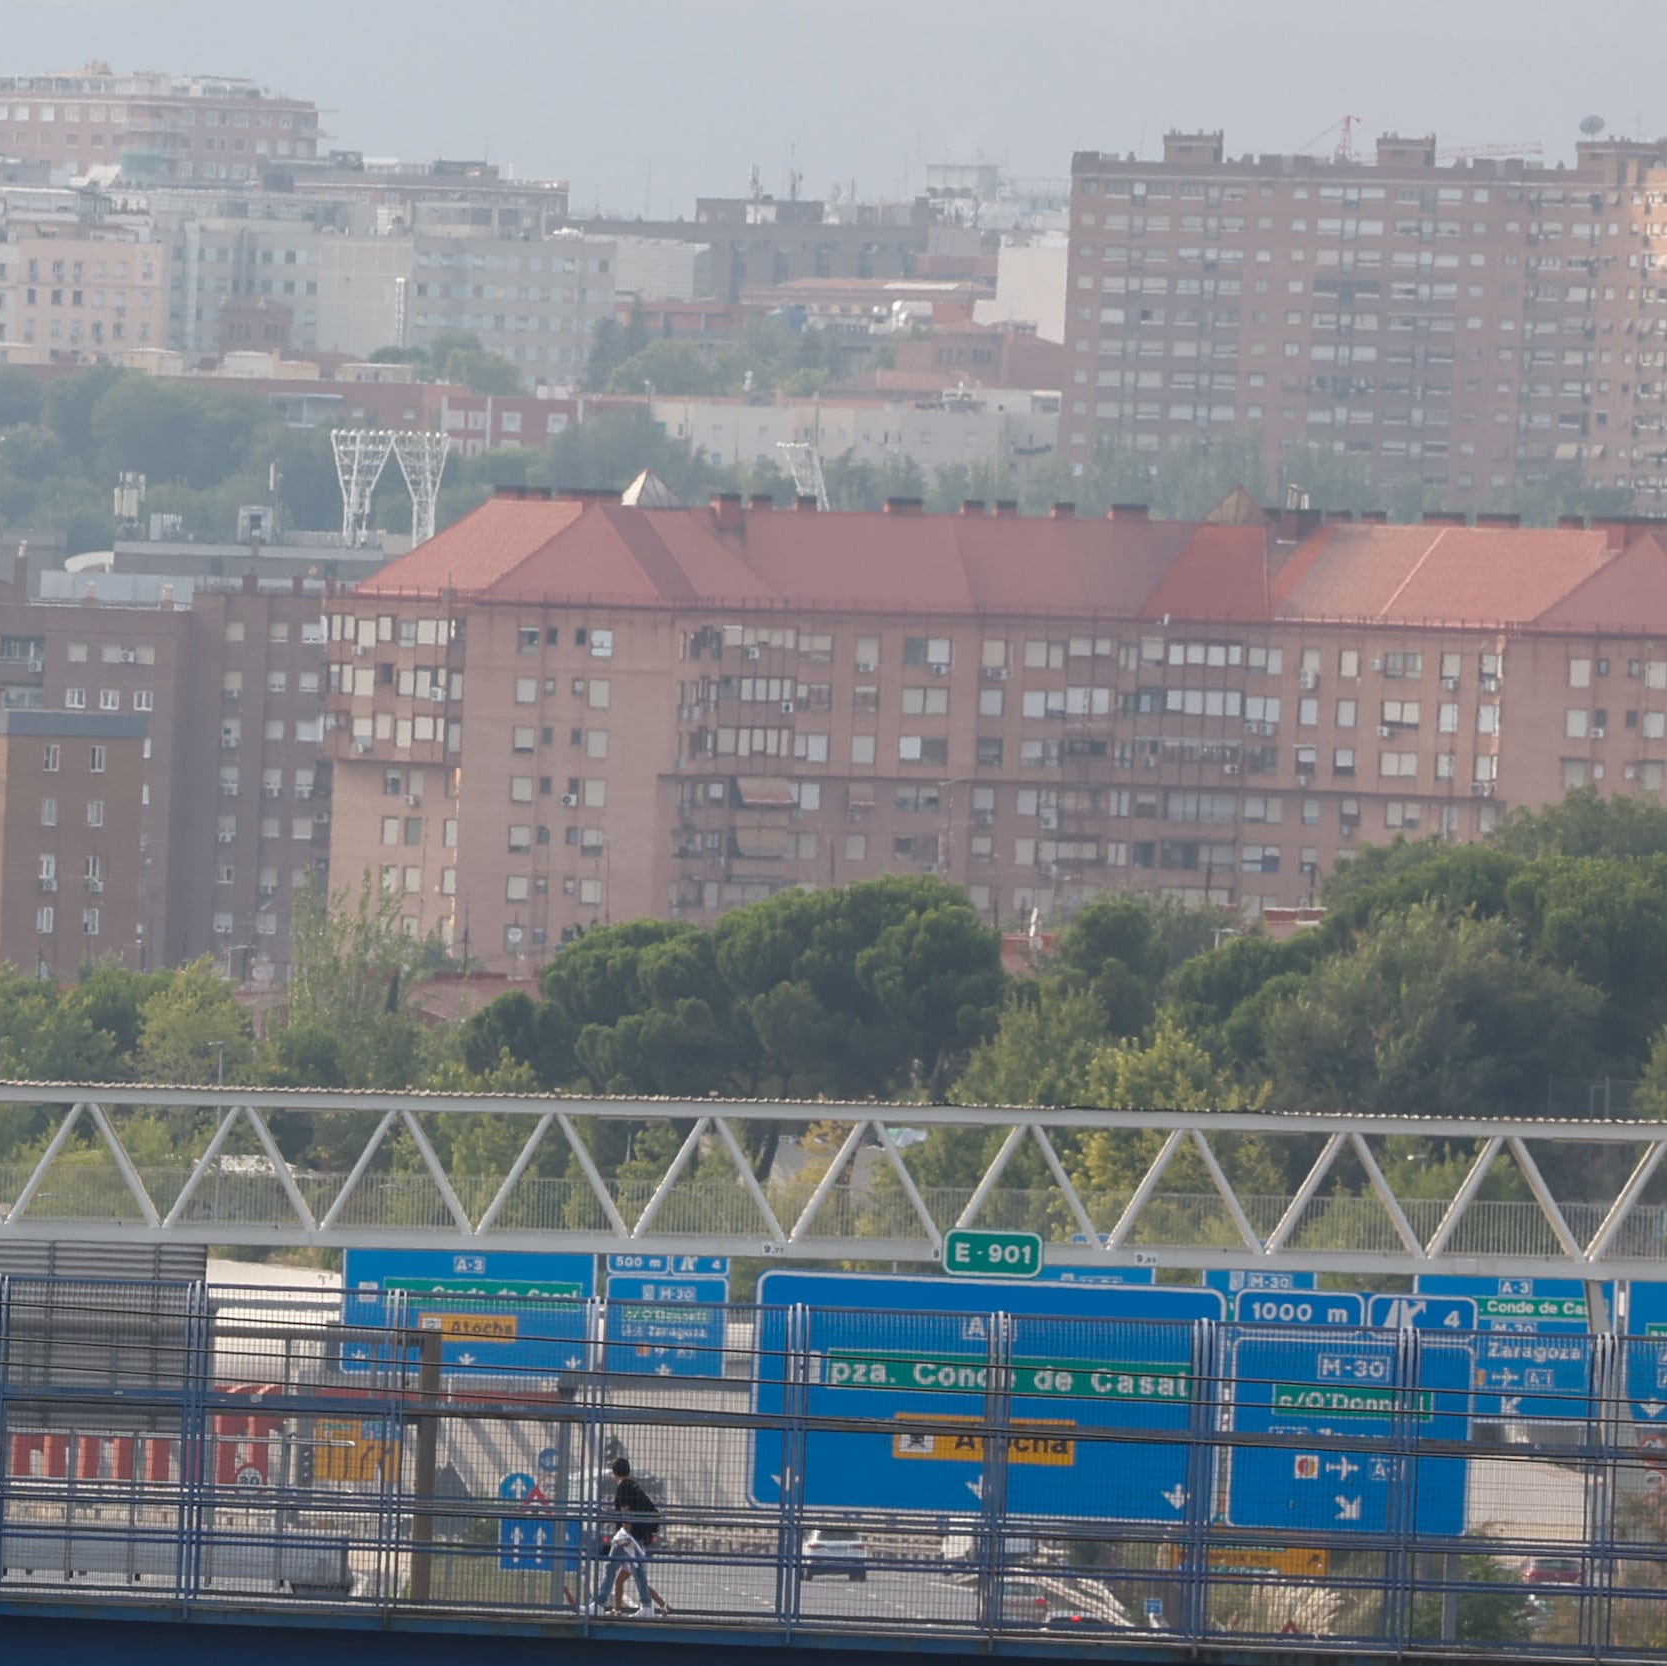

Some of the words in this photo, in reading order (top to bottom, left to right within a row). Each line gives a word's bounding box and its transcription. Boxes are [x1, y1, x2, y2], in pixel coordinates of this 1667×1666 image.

[456, 1258, 484, 1271] A-3
[649, 1258, 662, 1269] m
[711, 1260, 722, 1270] 4
[1250, 1275, 1290, 1289] M-30
[1501, 1281, 1530, 1294] A-3
[1251, 1302, 1313, 1322] 1000
[1327, 1307, 1348, 1323] m
[1487, 1301, 1534, 1314] Conde
[1539, 1302, 1558, 1315] de
[1444, 1310, 1461, 1328] 4
[450, 1320, 514, 1336] Atocha
[1488, 1342, 1581, 1362] Zaragoza
[1321, 1358, 1385, 1378] M-30
[830, 1362, 897, 1386] pza.
[912, 1363, 1015, 1389] Con
[1034, 1368, 1073, 1391] de
[1090, 1368, 1188, 1397] Casal
[954, 1434, 1068, 1455] Acha
